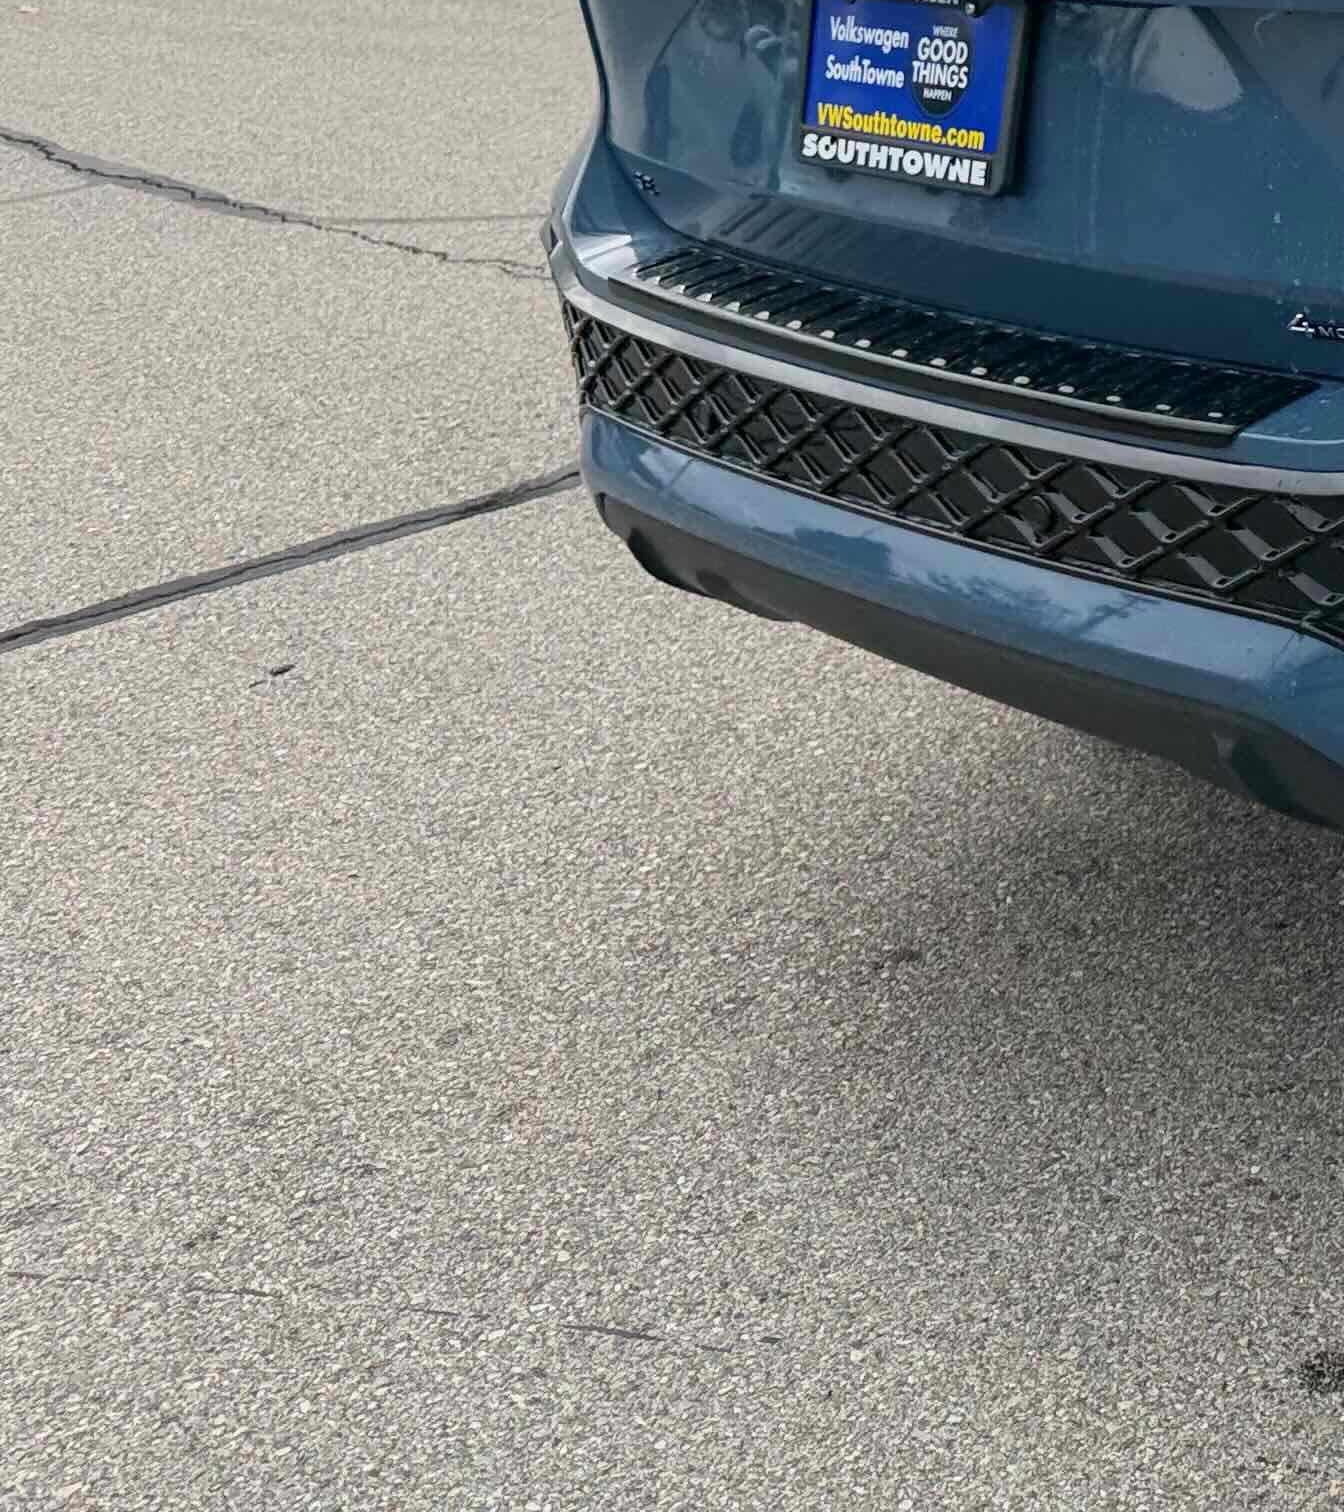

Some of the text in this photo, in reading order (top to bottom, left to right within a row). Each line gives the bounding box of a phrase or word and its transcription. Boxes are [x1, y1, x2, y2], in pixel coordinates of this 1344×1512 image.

[830, 15, 910, 54] Volkswagen
[932, 25, 959, 38] WHERE
[917, 37, 969, 64] GOOD
[825, 54, 905, 88] SouthTowne
[911, 60, 969, 88] THINGS
[923, 88, 952, 101] HAPPEN
[817, 102, 985, 150] VWSouthtowne.com
[802, 133, 987, 186] SOUTHTOWNE
